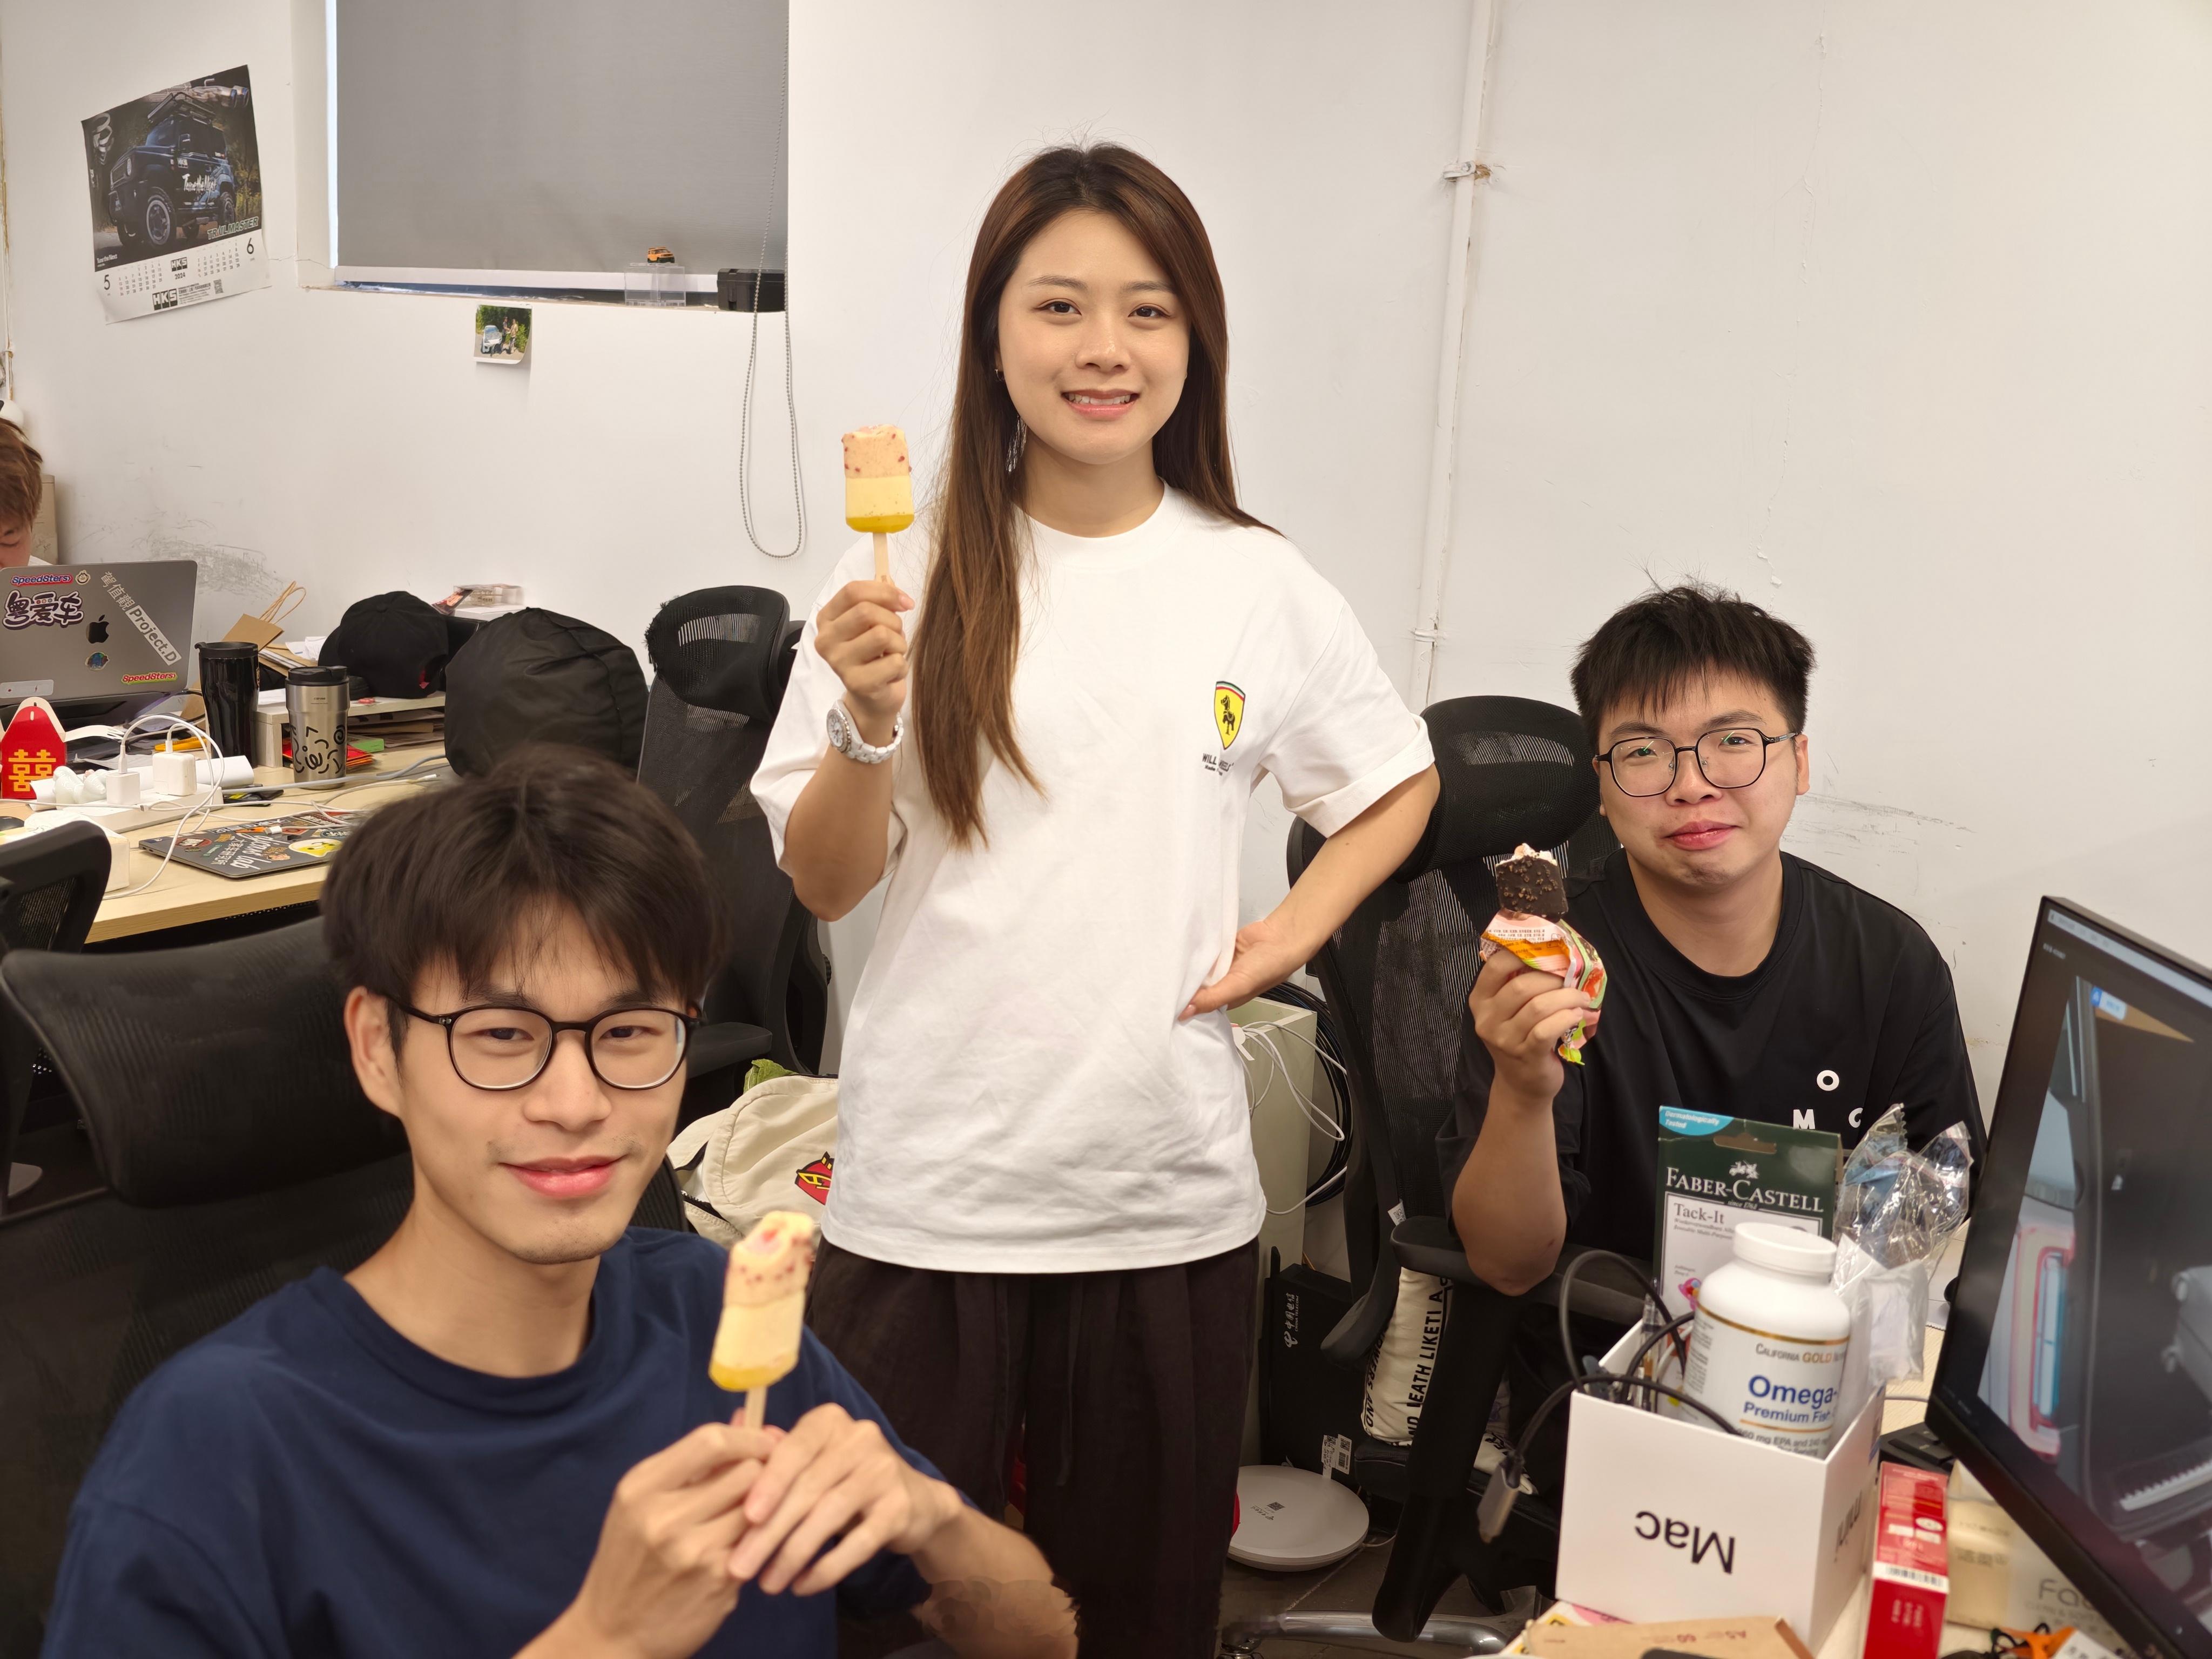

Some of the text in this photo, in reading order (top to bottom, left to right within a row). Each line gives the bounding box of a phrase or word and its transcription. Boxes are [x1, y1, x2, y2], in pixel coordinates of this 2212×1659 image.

[247, 238, 254, 254] 6
[171, 257, 187, 272] HKS
[104, 274, 110, 290] 5
[152, 288, 178, 311] HKS
[129, 608, 177, 662] Project.D
[1202, 753, 1217, 765] WILL
[1816, 1069, 1840, 1091] O
[1793, 1109, 1816, 1130] M
[1665, 1166, 1824, 1213] FABER-CASTELL
[1674, 1203, 1724, 1224] Tack-It
[1756, 1343, 1800, 1361] CALIFORNIA
[1802, 1352, 1832, 1364] GOLD
[1744, 1401, 1810, 1422] Premium
[1773, 1437, 1791, 1446] EPA
[1635, 1510, 1736, 1575] Mac
